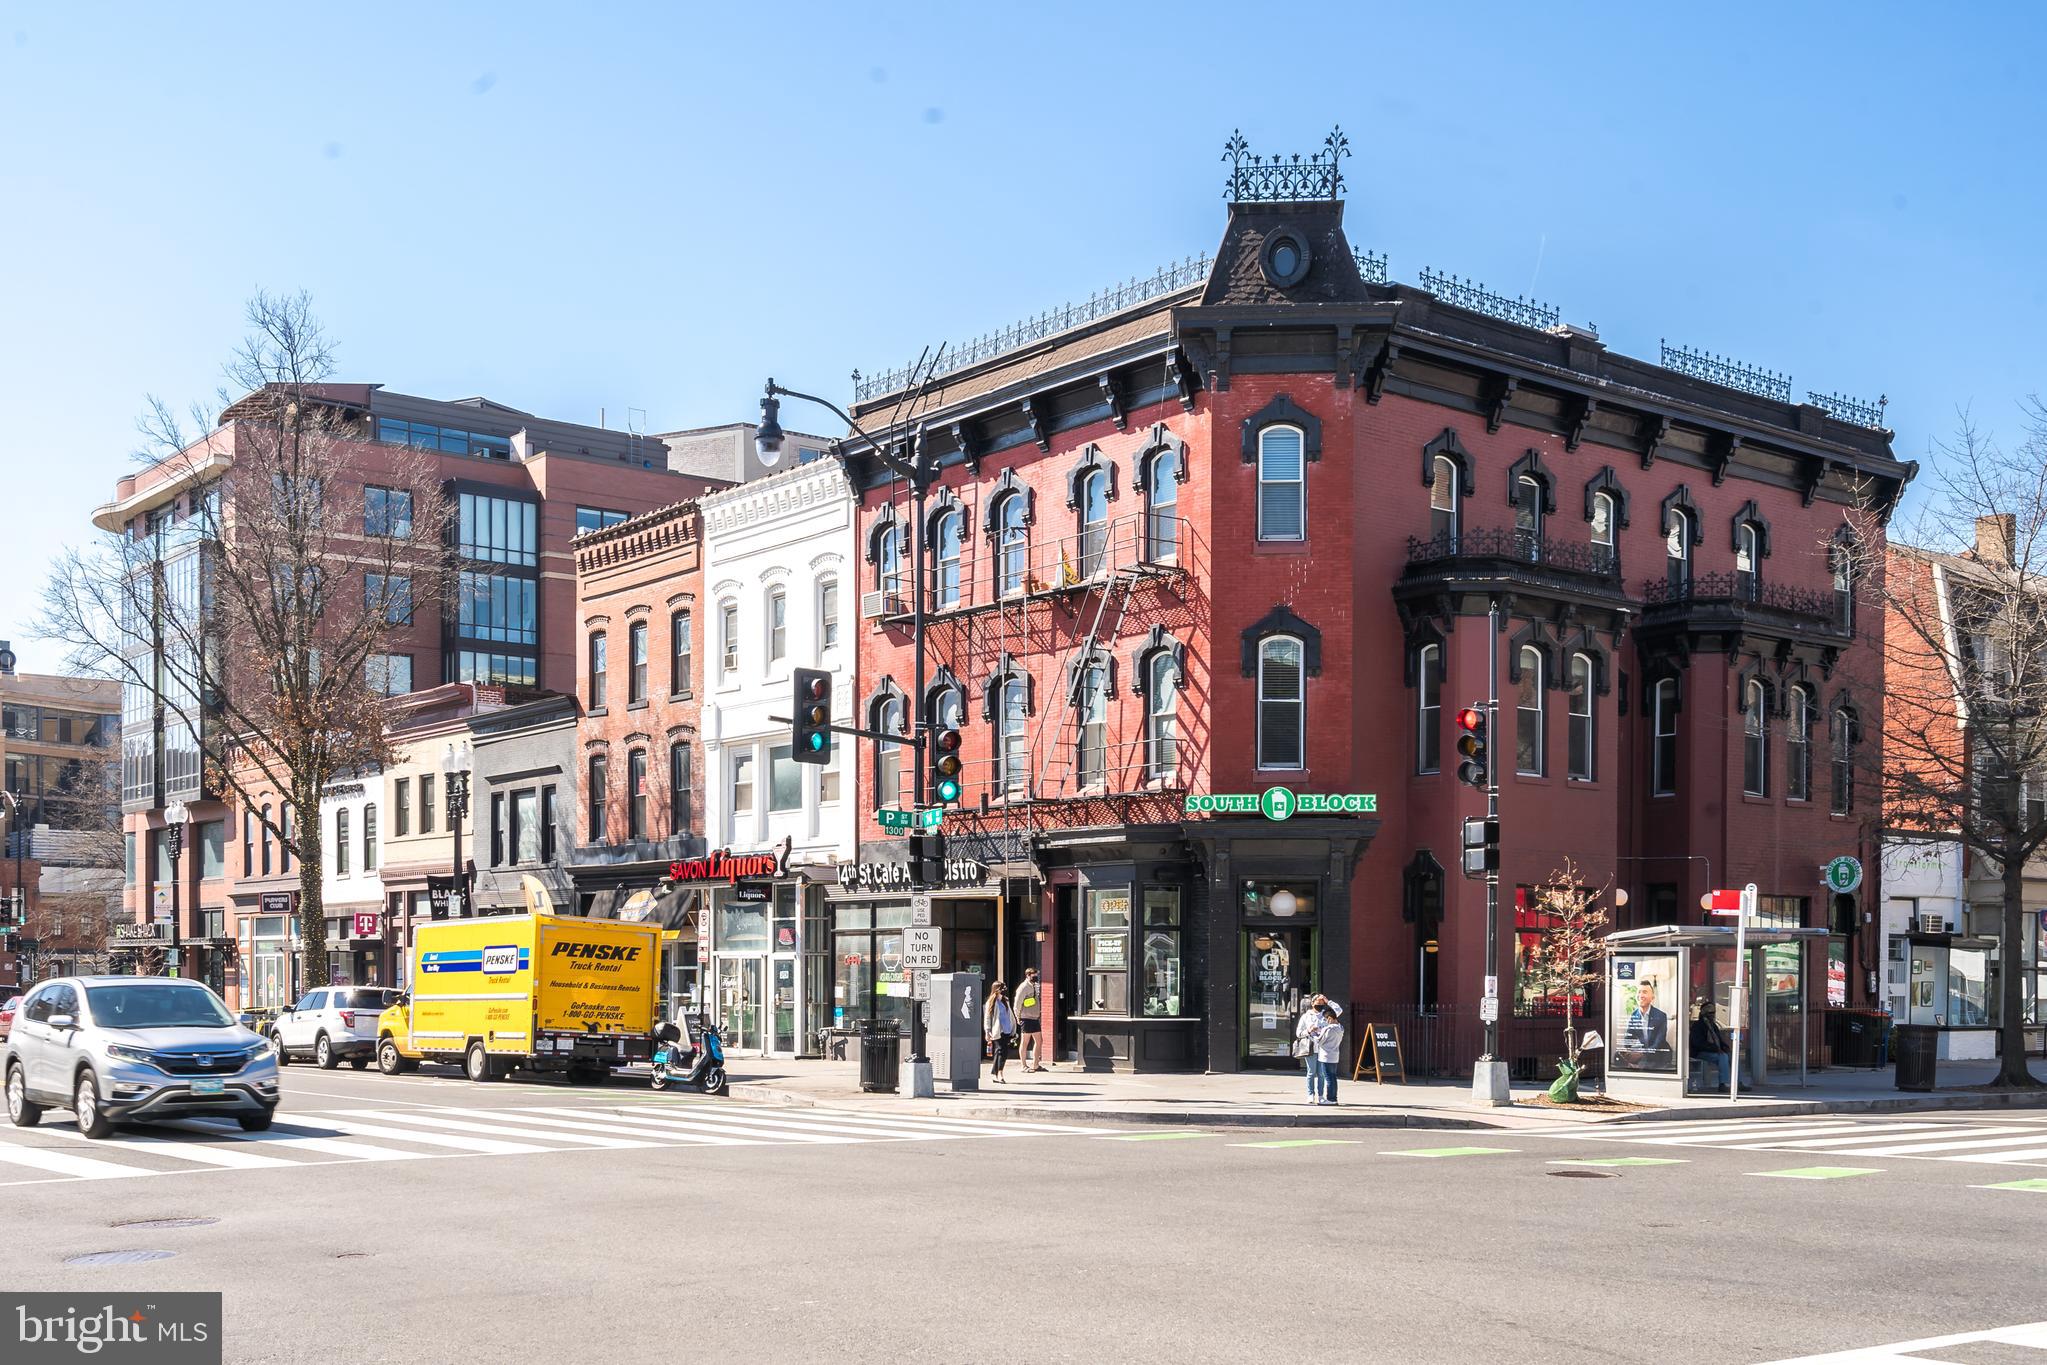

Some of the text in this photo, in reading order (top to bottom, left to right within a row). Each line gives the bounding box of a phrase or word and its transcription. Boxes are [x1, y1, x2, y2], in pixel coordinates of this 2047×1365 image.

[1186, 793, 1377, 812] SOUTH BLOCK
[886, 812, 895, 824] P
[885, 826, 904, 836] 1300
[669, 850, 776, 885] SAVON Liquors
[836, 864, 857, 886] 14th
[859, 863, 871, 885] St
[873, 862, 900, 884] Cafe
[944, 860, 977, 881] istro
[739, 891, 766, 900] Liquors
[915, 932, 929, 940] NO
[551, 941, 641, 962] PENSKE
[910, 943, 933, 952] TURN
[486, 954, 515, 965] PENSKE
[905, 955, 938, 964] ON RED
[570, 961, 622, 973] Truck Rental
[549, 980, 583, 989] Household
[589, 983, 618, 991] Business
[618, 984, 641, 992] Rentals
[563, 1010, 626, 1021] 1-800-GO-PENSKE
